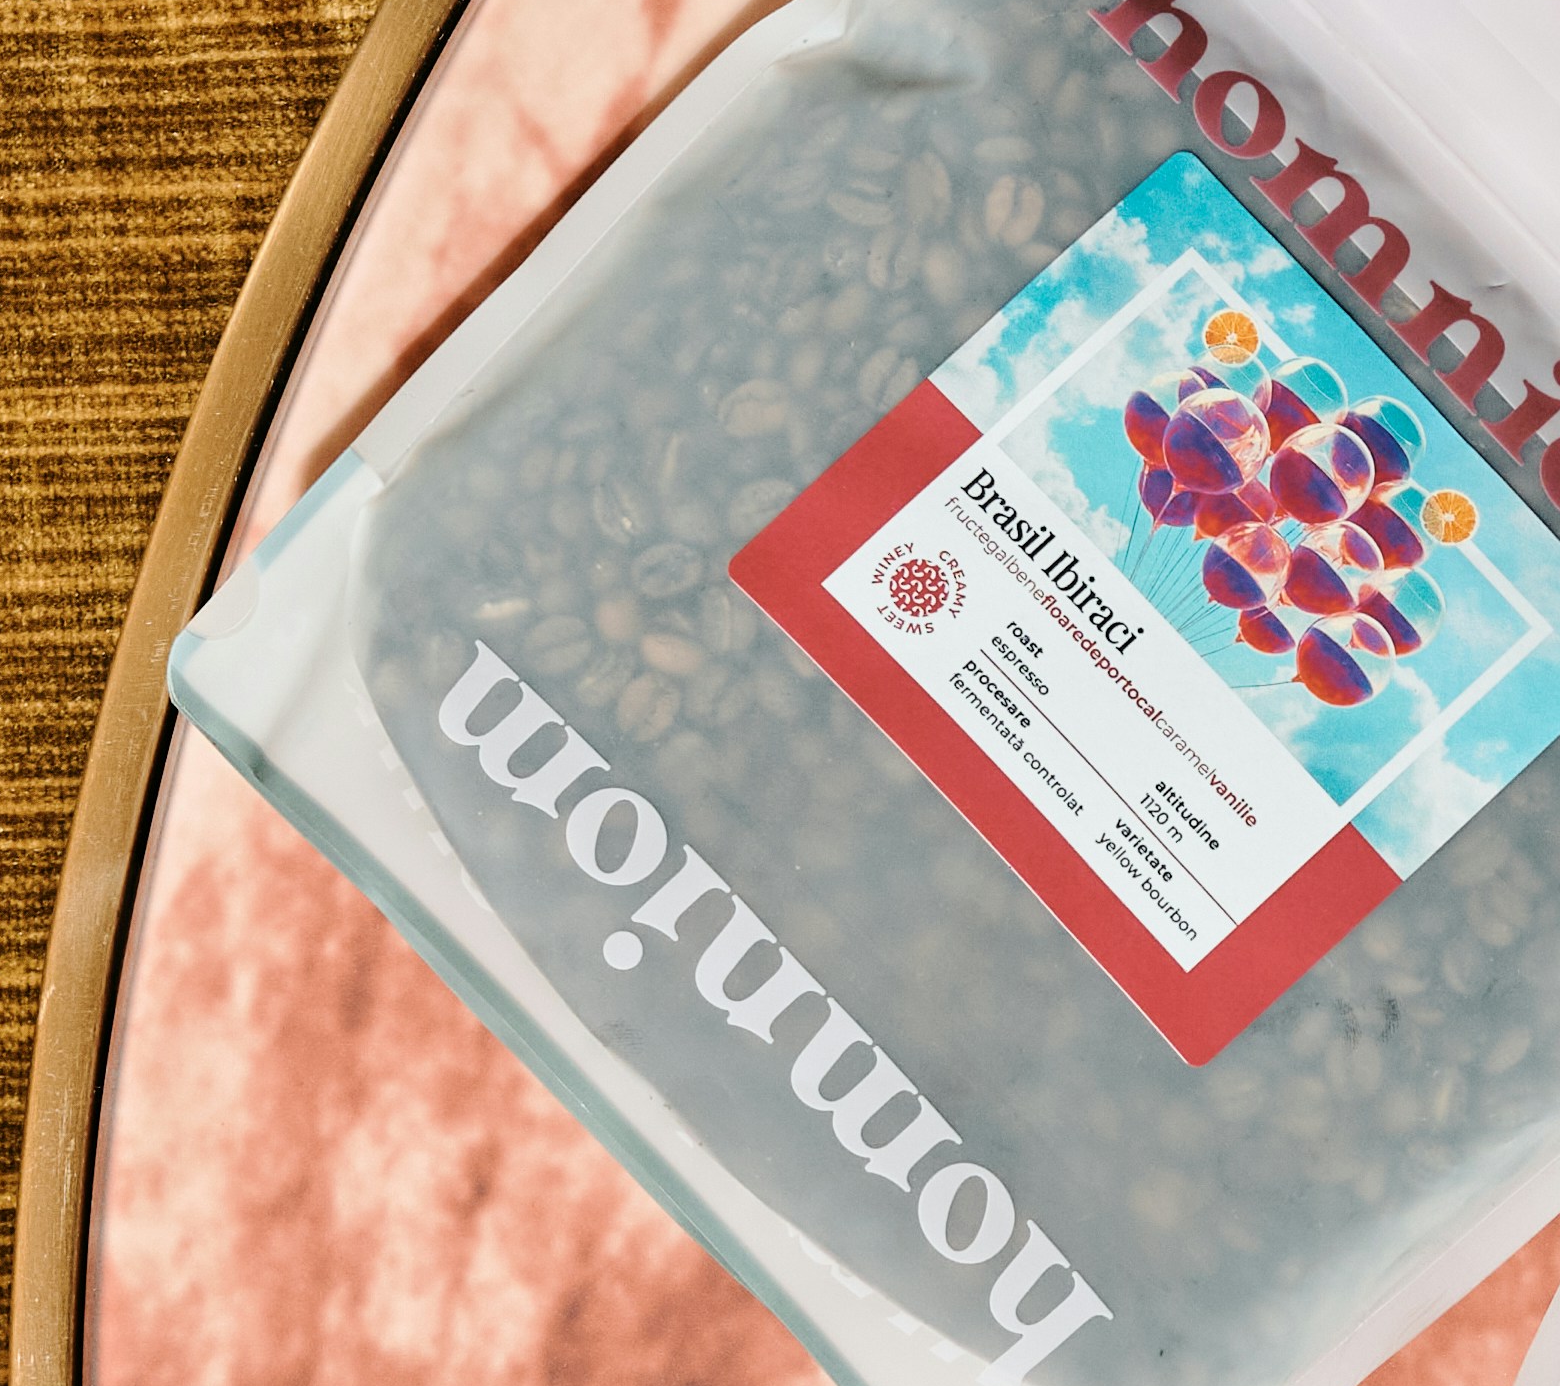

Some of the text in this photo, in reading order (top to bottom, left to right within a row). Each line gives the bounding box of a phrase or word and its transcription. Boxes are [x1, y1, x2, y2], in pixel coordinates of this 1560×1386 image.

[872, 543, 913, 584] WINEY
[939, 551, 967, 619] CREAMY
[960, 467, 1144, 655] Brasil Ibiraci
[877, 606, 934, 635] SWEET
[1006, 621, 1043, 658] roast
[962, 660, 1030, 728] procesare
[992, 636, 1049, 695] espresso
[949, 673, 1083, 816] fermentată controlat
[1140, 793, 1183, 843] 1120 m
[1155, 781, 1219, 850] altitudine
[1116, 818, 1173, 882] varietate
[1095, 832, 1197, 941] yellow bourbon
